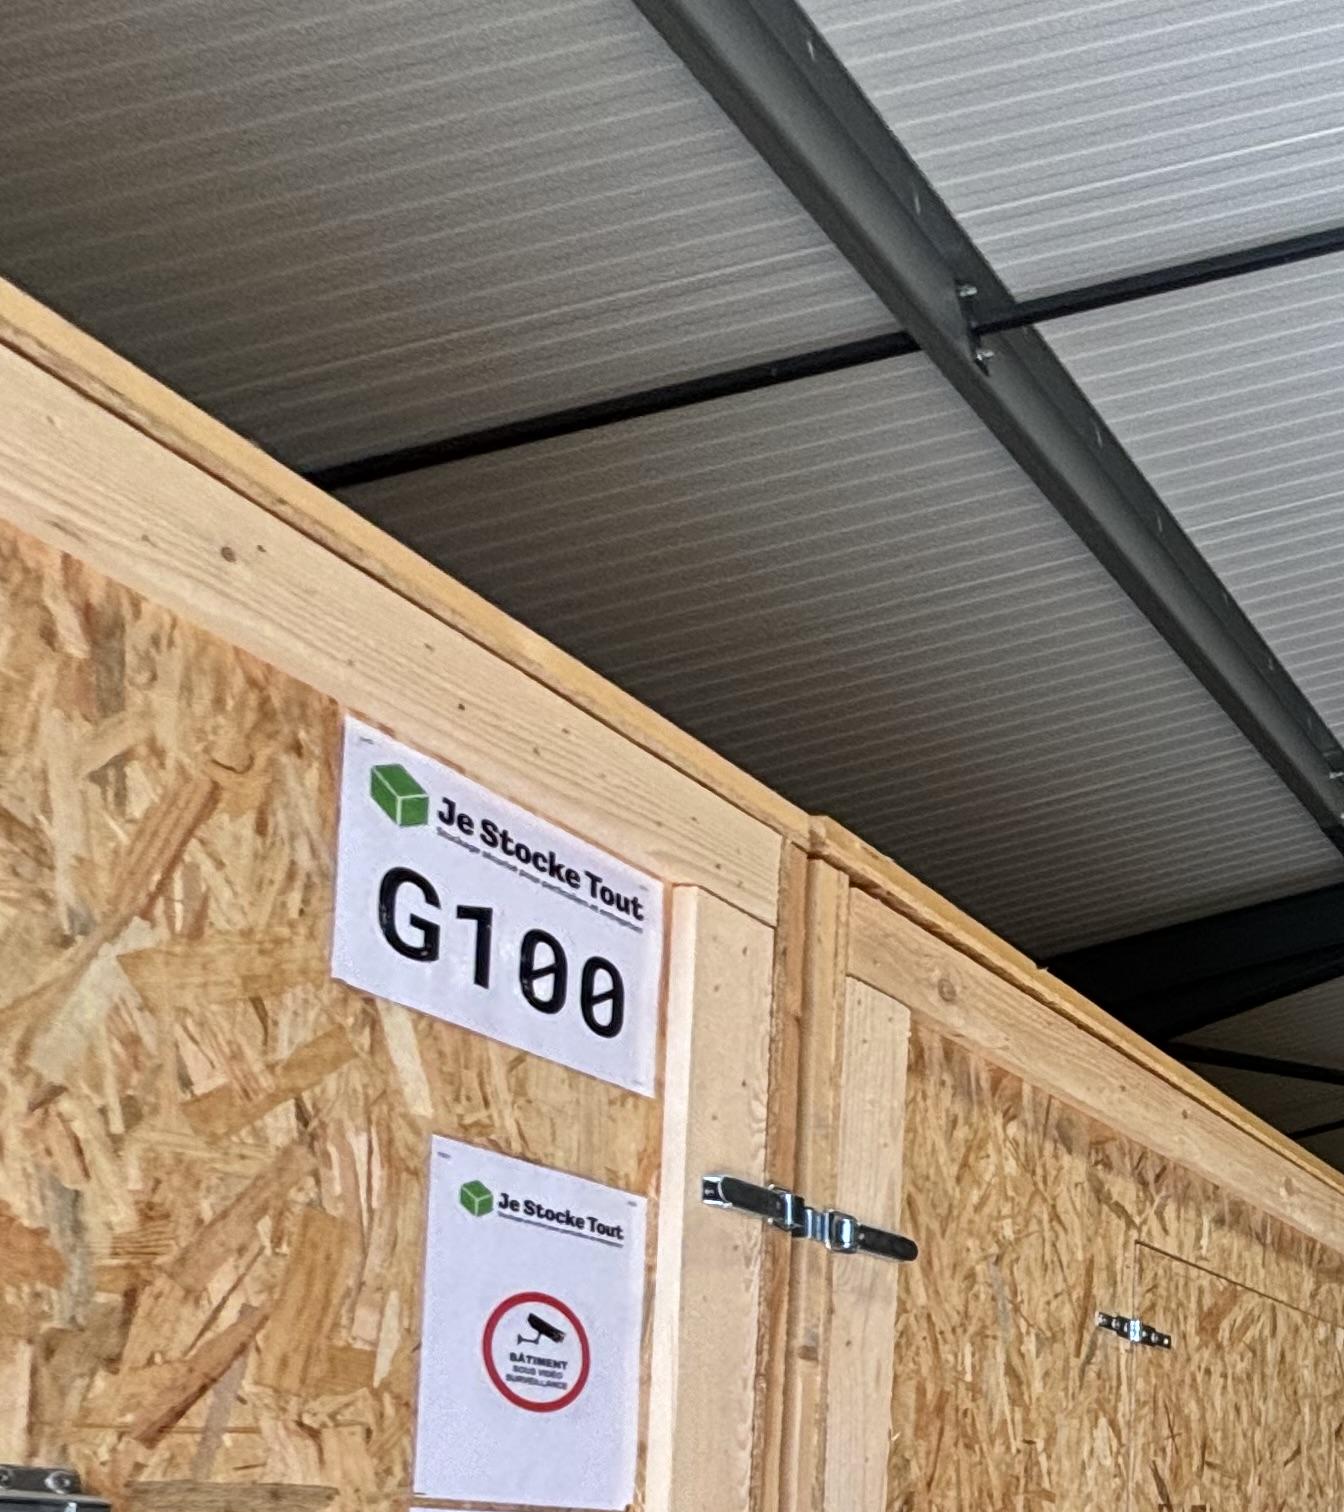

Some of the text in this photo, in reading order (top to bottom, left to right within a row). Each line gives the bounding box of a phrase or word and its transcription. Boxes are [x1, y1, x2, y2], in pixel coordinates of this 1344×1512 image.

[438, 797, 475, 836] Je
[479, 818, 581, 890] Stocke
[584, 870, 645, 922] Tout
[377, 866, 626, 1039] G100
[498, 1192, 520, 1212] Je
[523, 1199, 585, 1230] Stocke
[586, 1216, 624, 1240] Tout
